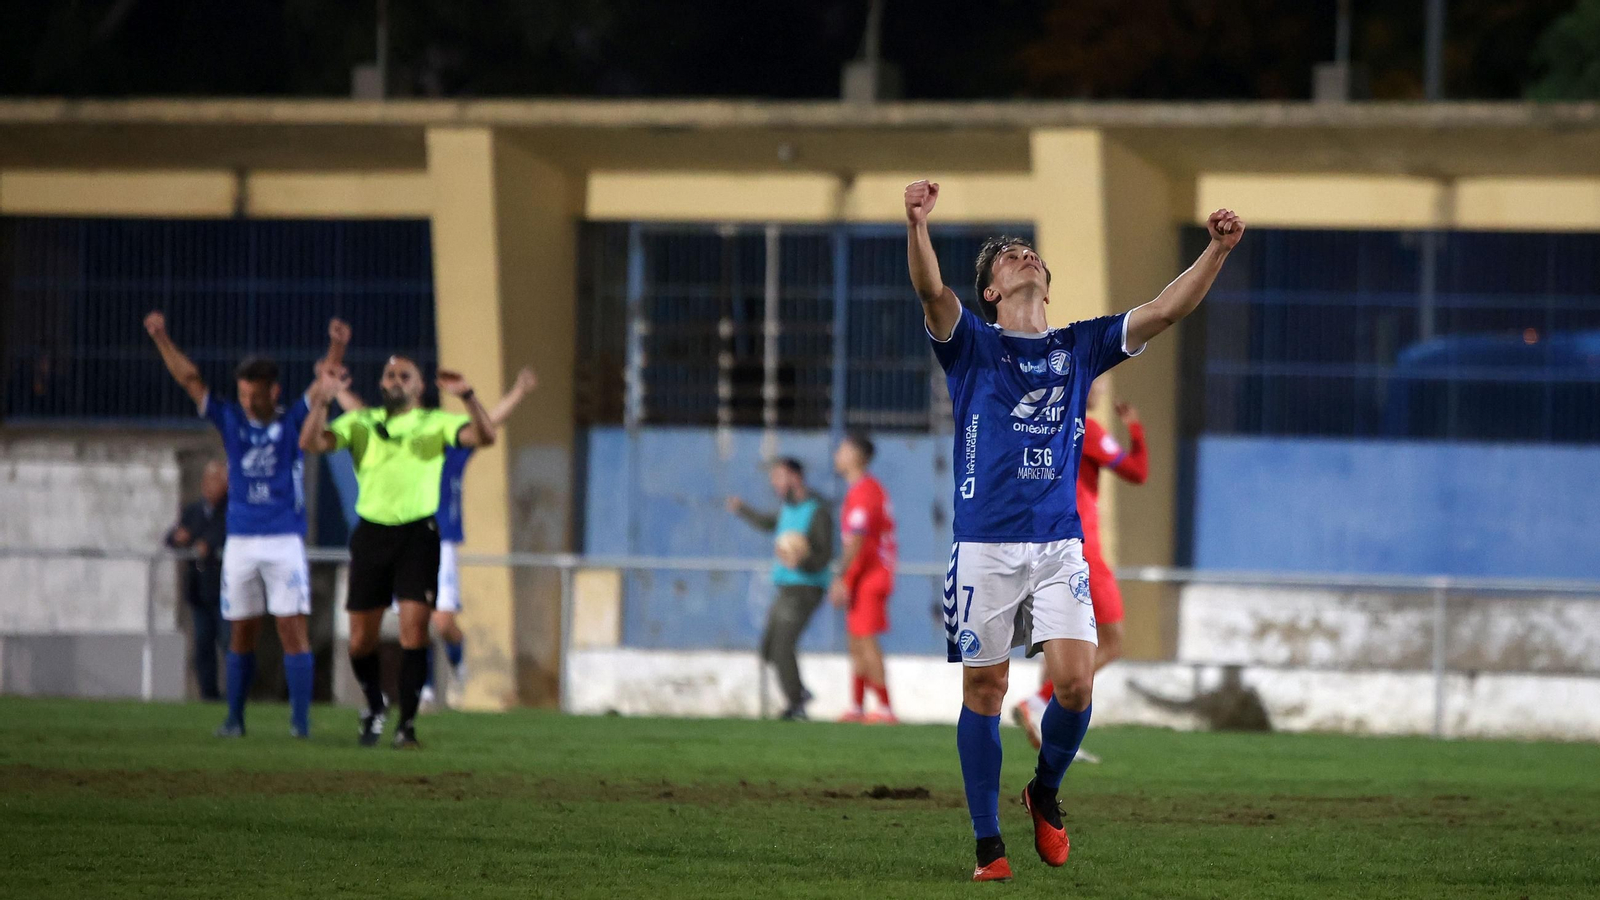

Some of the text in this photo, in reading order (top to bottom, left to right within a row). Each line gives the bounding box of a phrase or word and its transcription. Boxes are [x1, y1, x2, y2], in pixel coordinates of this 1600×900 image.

[970, 413, 979, 474] INTELIGENTE
[1023, 447, 1053, 467] L3G
[965, 463, 971, 475] LA
[1016, 467, 1056, 480] MARKETING
[962, 585, 975, 623] 7
